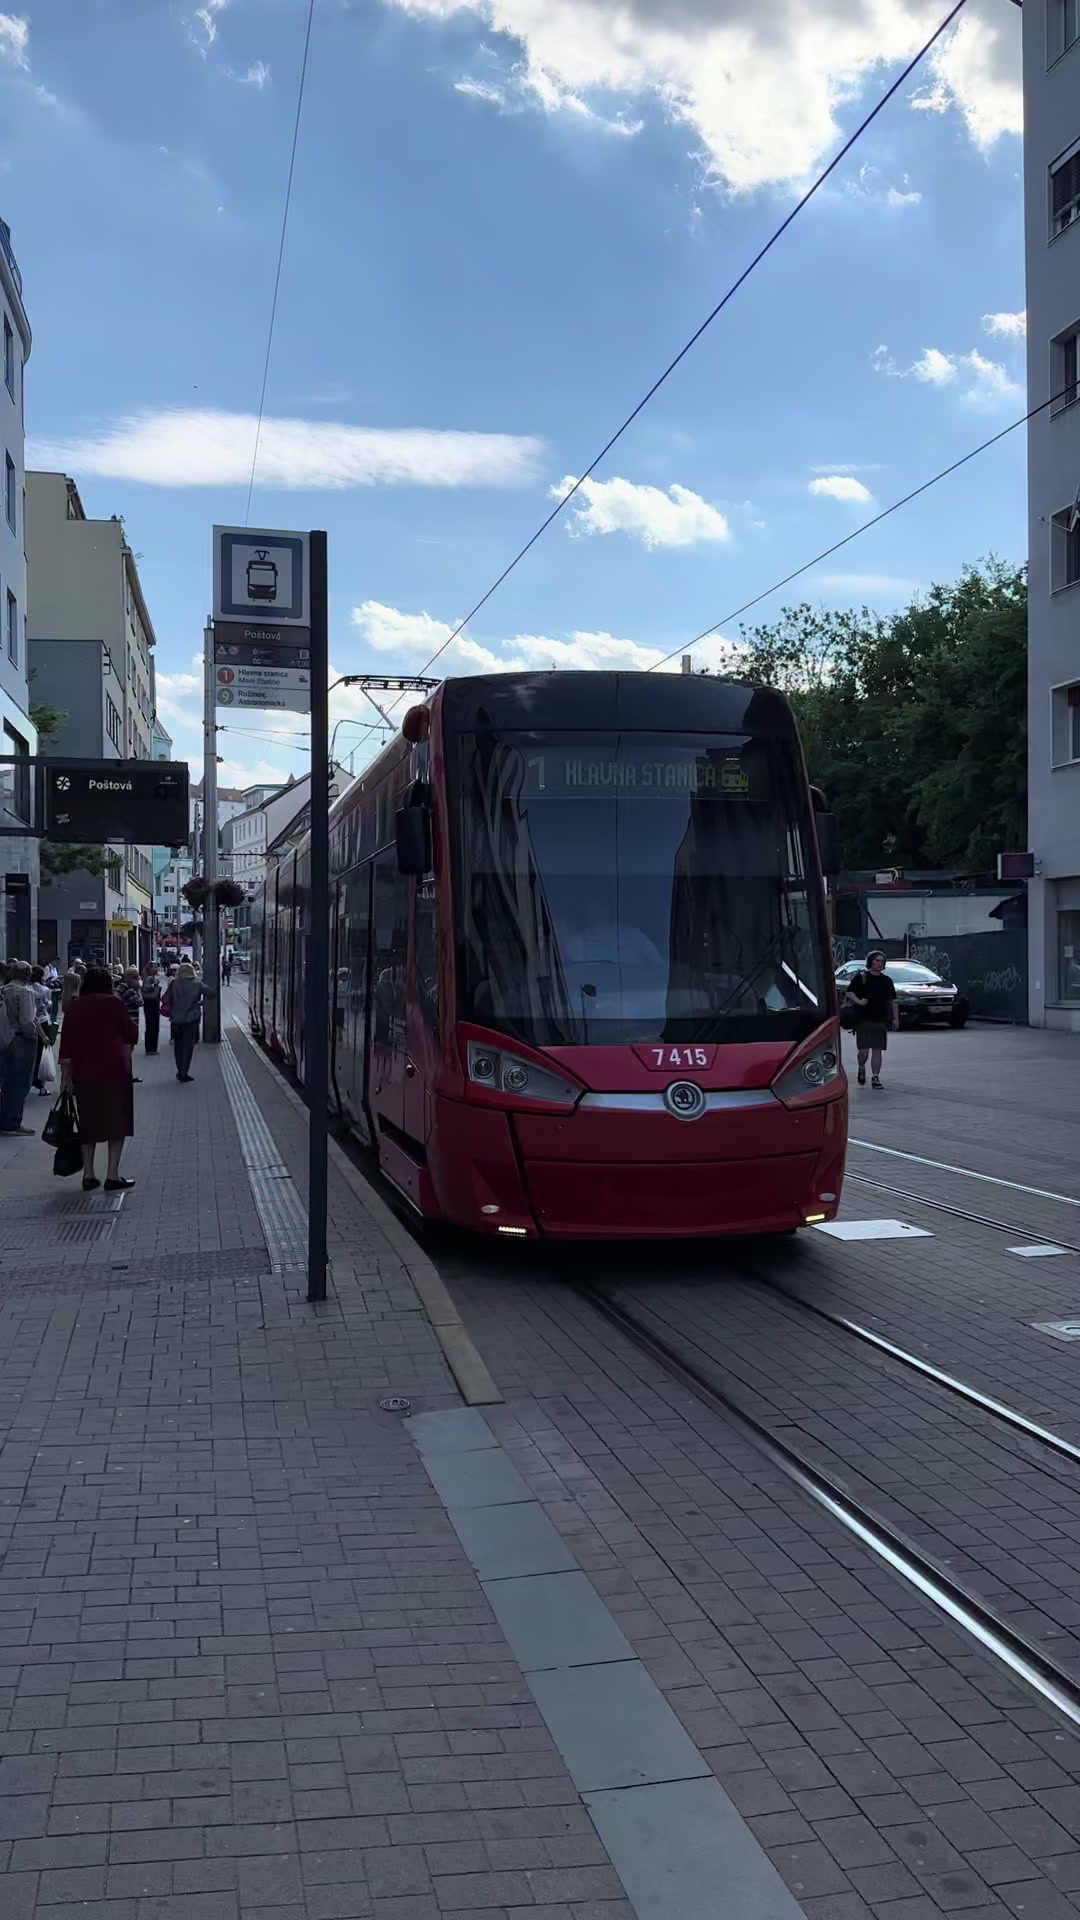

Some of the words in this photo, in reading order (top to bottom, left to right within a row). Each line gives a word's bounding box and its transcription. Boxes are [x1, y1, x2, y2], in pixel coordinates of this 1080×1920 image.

[528, 756, 545, 789] 1
[88, 780, 133, 791] Poštová
[652, 1048, 707, 1066] 7415
